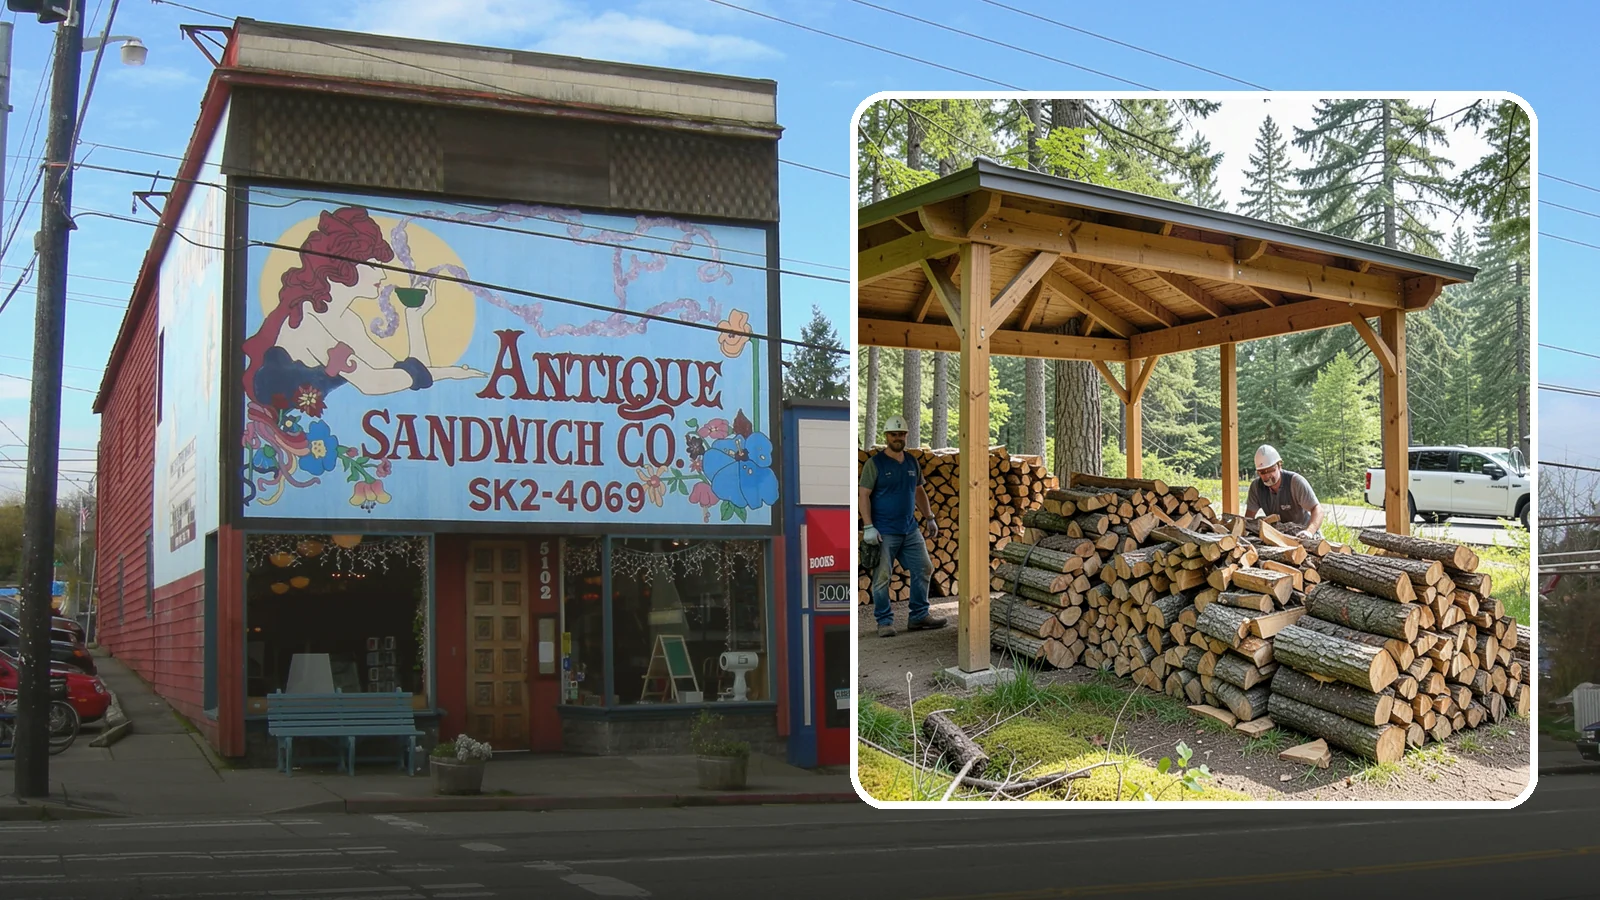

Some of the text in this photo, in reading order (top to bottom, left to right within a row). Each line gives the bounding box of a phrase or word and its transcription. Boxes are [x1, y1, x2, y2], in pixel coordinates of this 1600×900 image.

[476, 329, 723, 421] ANTIQUE
[361, 408, 685, 469] SANDWICH CO.
[468, 477, 646, 513] SK2-4069
[539, 541, 552, 600] 5102
[809, 555, 835, 569] BOOKS
